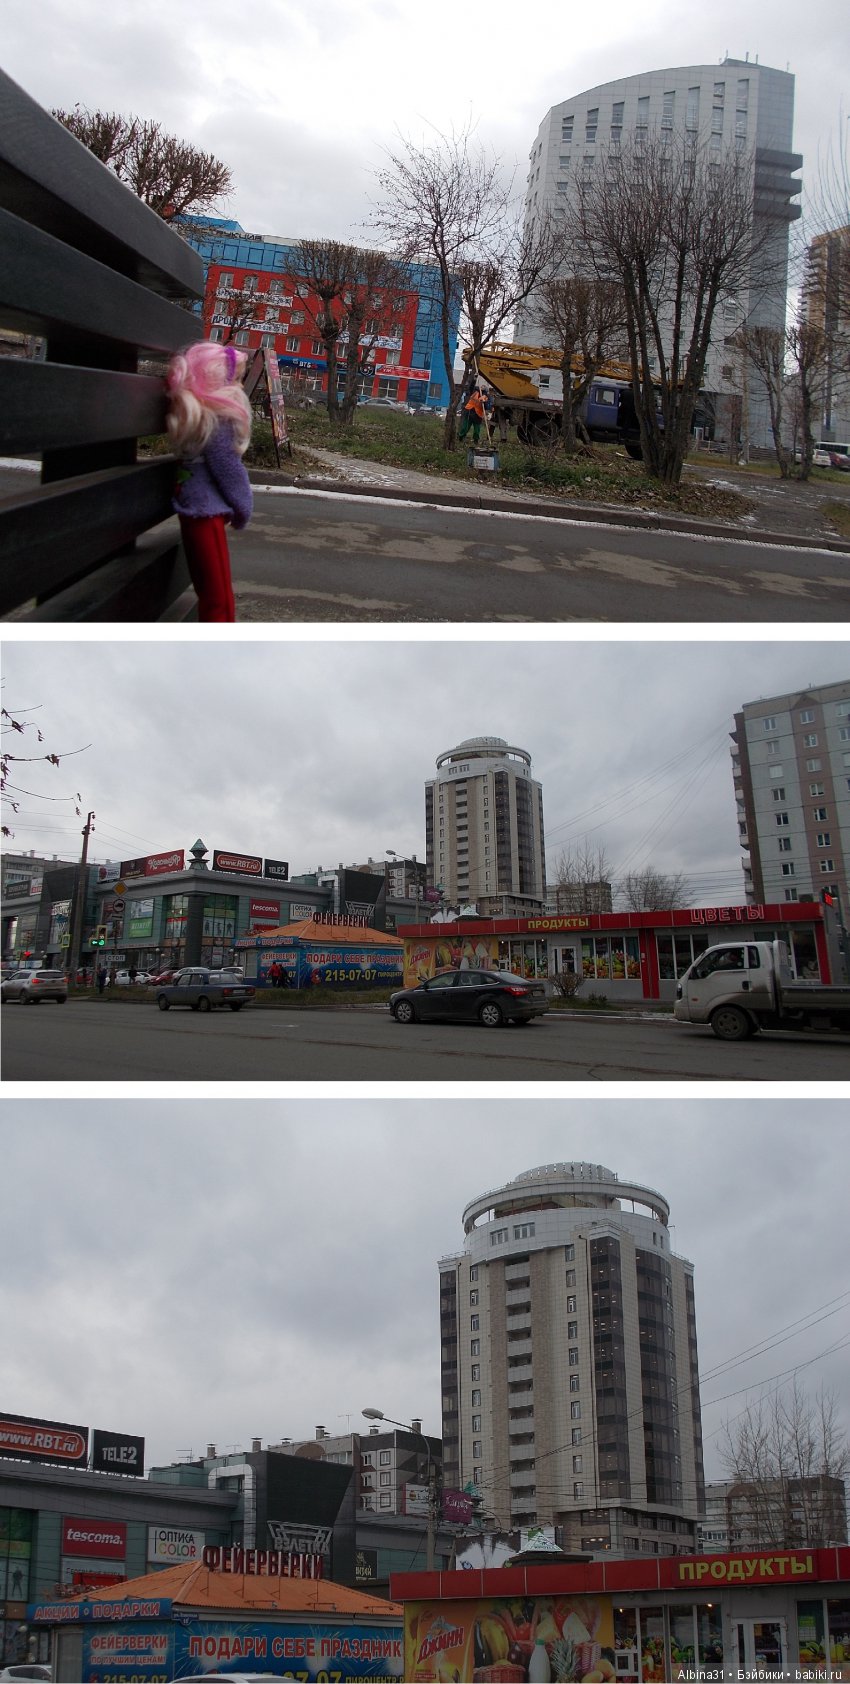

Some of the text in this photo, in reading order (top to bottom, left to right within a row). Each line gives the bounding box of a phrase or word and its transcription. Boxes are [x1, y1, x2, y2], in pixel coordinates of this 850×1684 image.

[269, 866, 286, 876] TELE2
[312, 910, 370, 928] ФЕЙЕРВЕРКИ
[527, 917, 590, 929] ПРОДУКТЫ
[691, 904, 765, 925] ЦВЕТЫ
[306, 953, 342, 965] ПОДАРИ
[344, 954, 365, 964] СЕБЕ
[367, 955, 403, 965] ПРАЗДНИК
[325, 969, 376, 982] 215-07-07
[102, 1446, 138, 1465] TELE2
[67, 1529, 124, 1546] tescoma.
[159, 1531, 196, 1545] ОПТИКА
[159, 1543, 197, 1558] COLOR
[202, 1541, 324, 1580] ФЕЙЕРВЕРКИ
[679, 1555, 813, 1581] ПРОДУКТЫ
[33, 1602, 161, 1621] АКЦИИ ПОДАРКИ
[91, 1634, 168, 1651] ФЕЙЕРВЕРКИ
[190, 1636, 402, 1661] ПОДАРИ СЕБЕ ПРАЗДНИК
